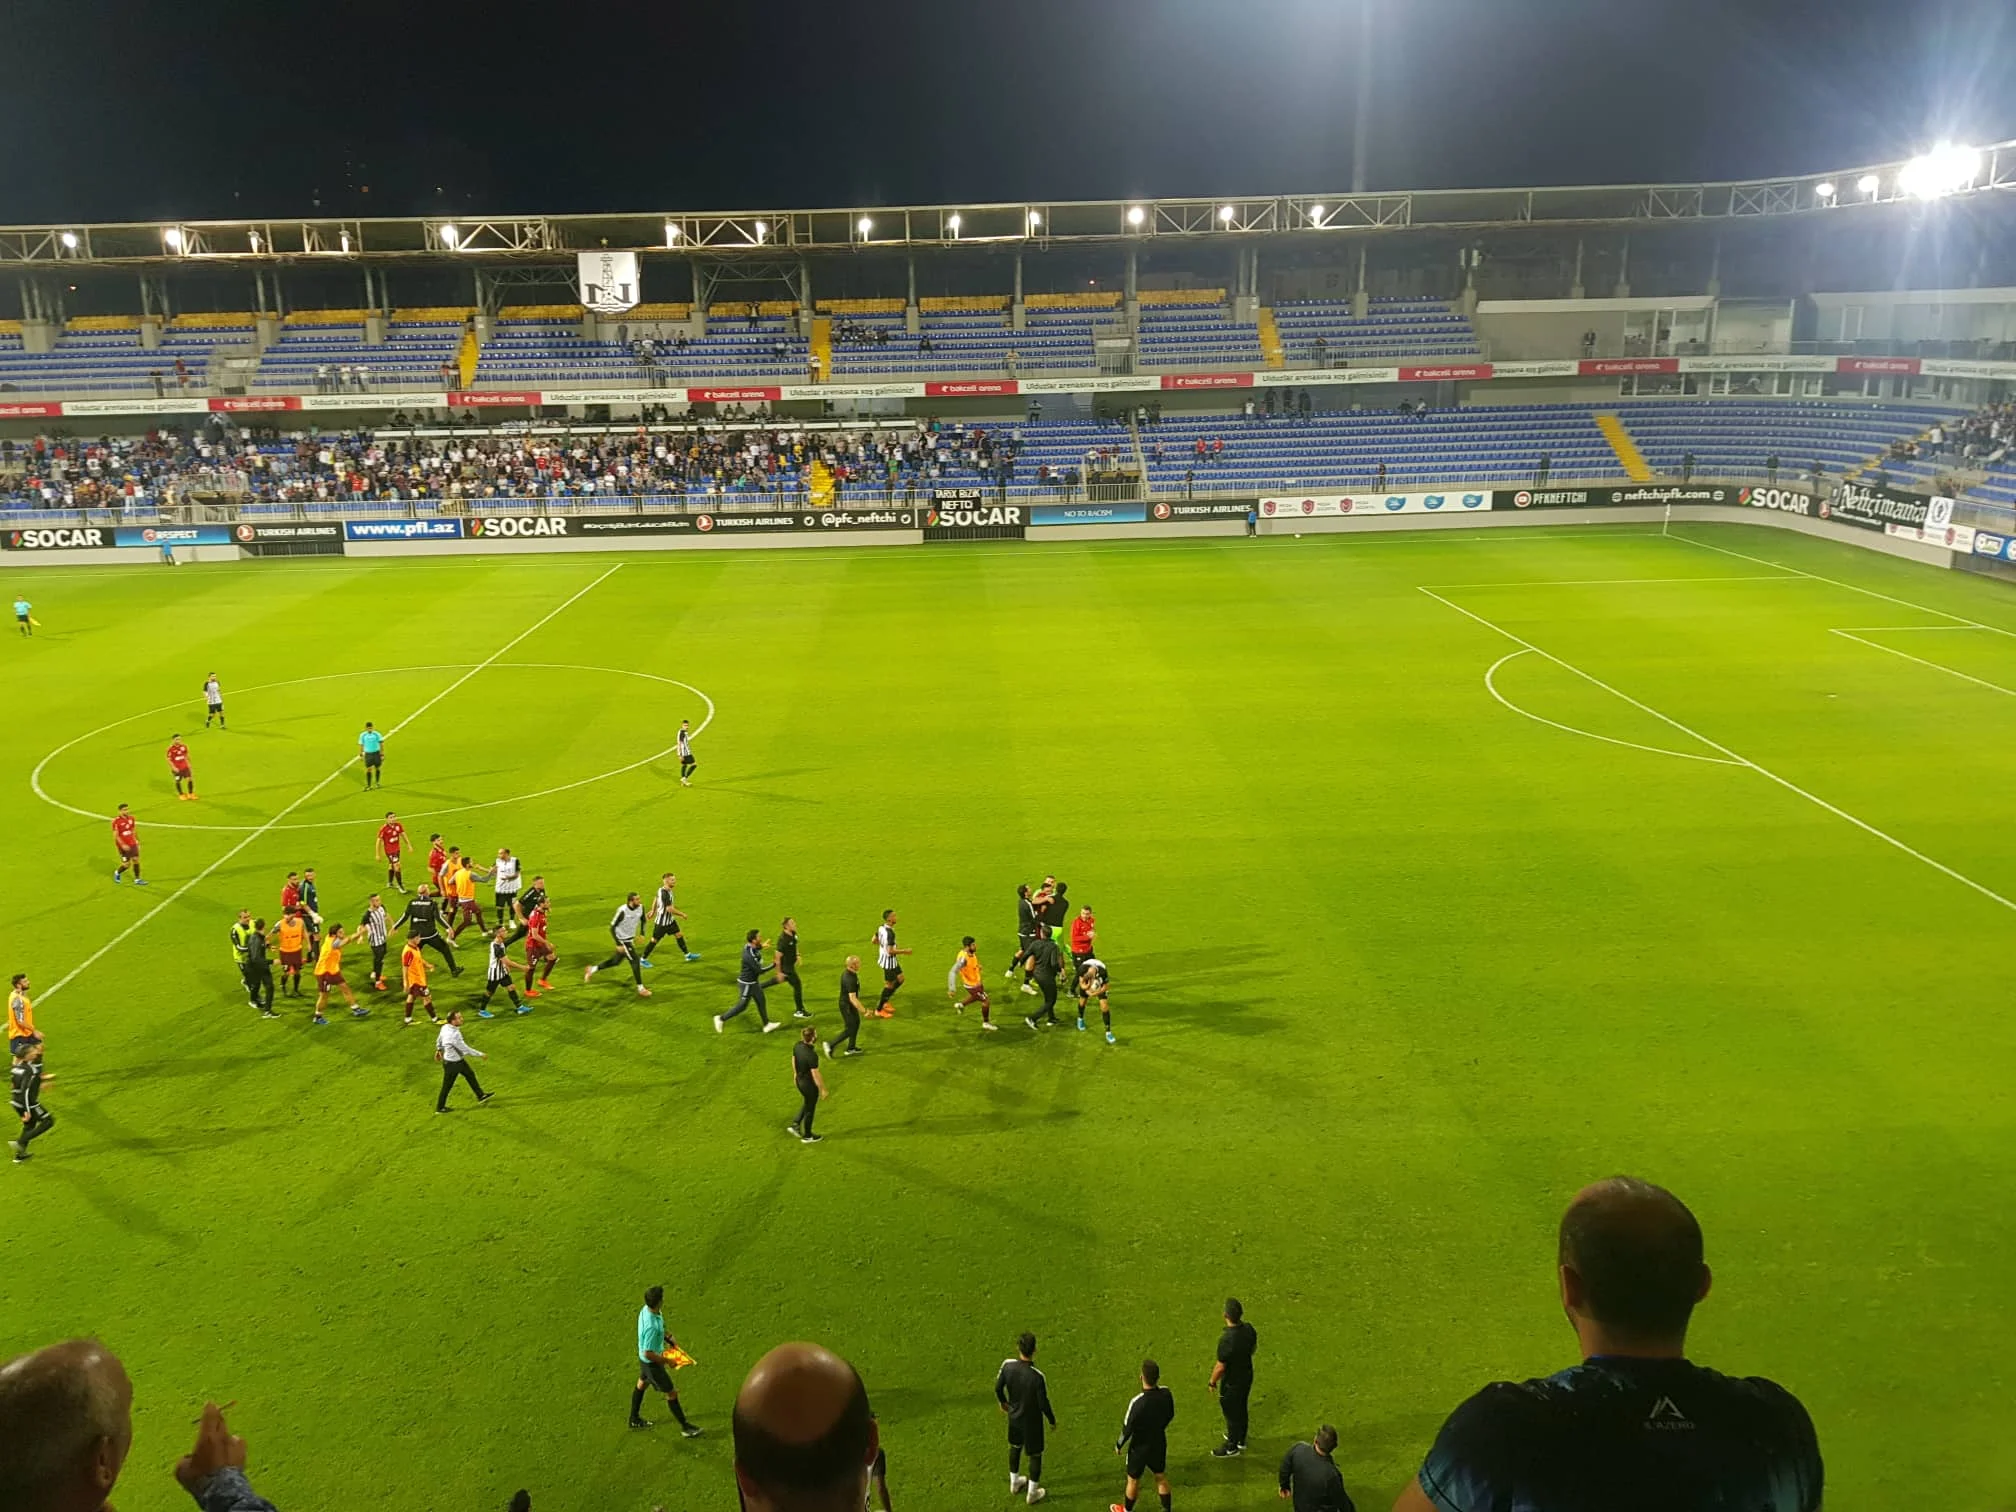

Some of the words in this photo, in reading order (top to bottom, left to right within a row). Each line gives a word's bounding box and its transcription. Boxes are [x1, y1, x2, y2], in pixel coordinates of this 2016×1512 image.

[741, 390, 765, 398] arena
[978, 384, 1002, 392] arena
[1624, 488, 1710, 502] neftchipfk.com
[1752, 488, 1810, 515] SOCAR
[1064, 510, 1076, 518] NO
[1173, 506, 1210, 515] TURKISH
[1212, 504, 1251, 513] AIRLINES
[755, 517, 794, 525] AIRLINES
[821, 512, 897, 527] @pfc_neftchi
[940, 507, 1020, 526] SOCAR
[256, 528, 294, 537] TURKISH
[297, 527, 337, 536] AIRLINES
[352, 521, 455, 536] www.pfl.az
[484, 517, 567, 536] SOCAR
[23, 528, 103, 547] SOCAR
[157, 530, 198, 540] RESPECT
